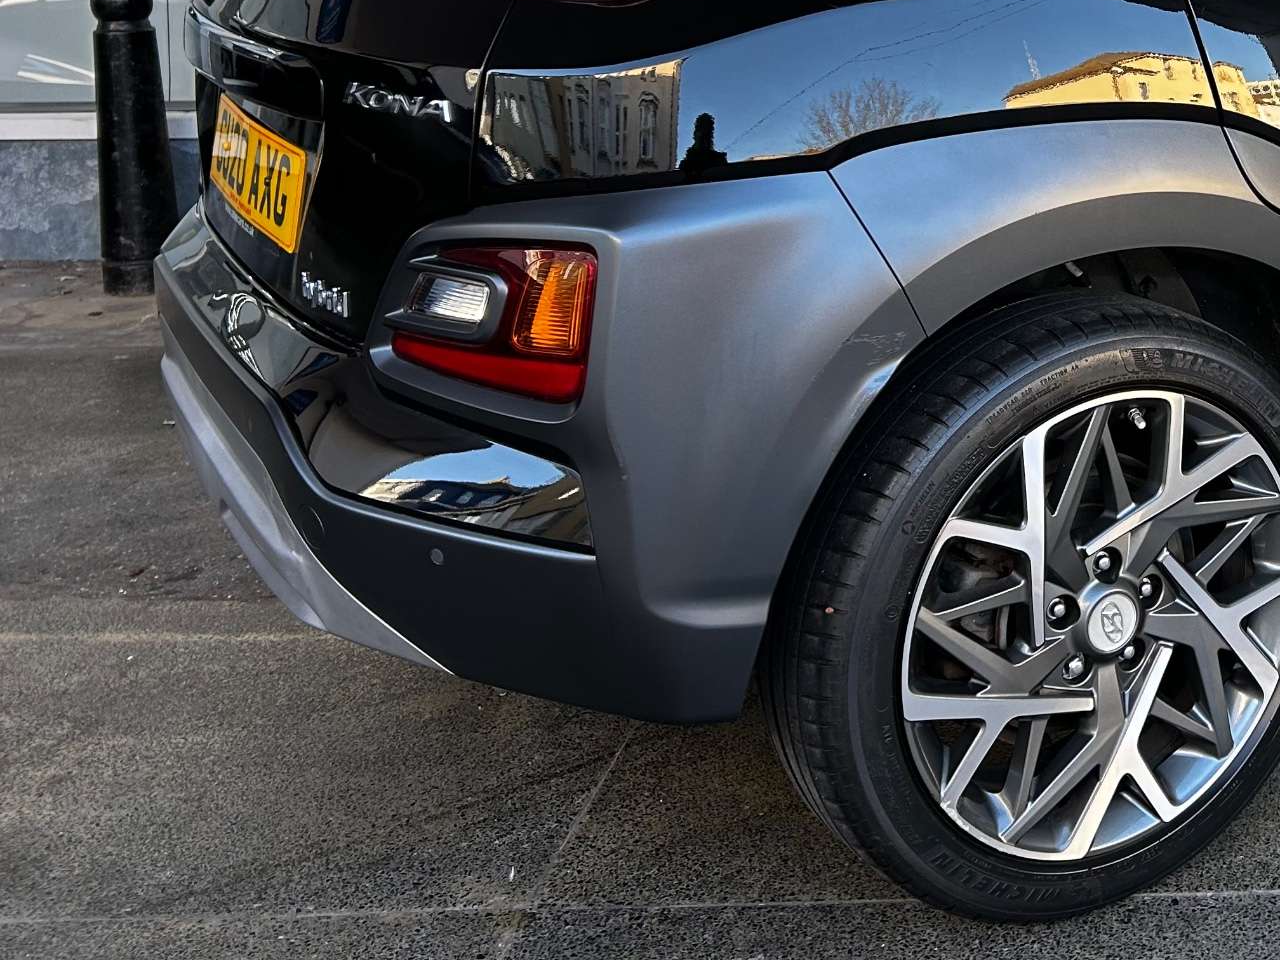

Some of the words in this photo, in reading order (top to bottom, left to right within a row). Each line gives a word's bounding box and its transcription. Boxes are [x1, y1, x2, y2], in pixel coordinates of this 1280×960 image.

[343, 82, 453, 123] KONA
[248, 138, 291, 227] AXG
[928, 849, 1061, 903] MICHELIN
